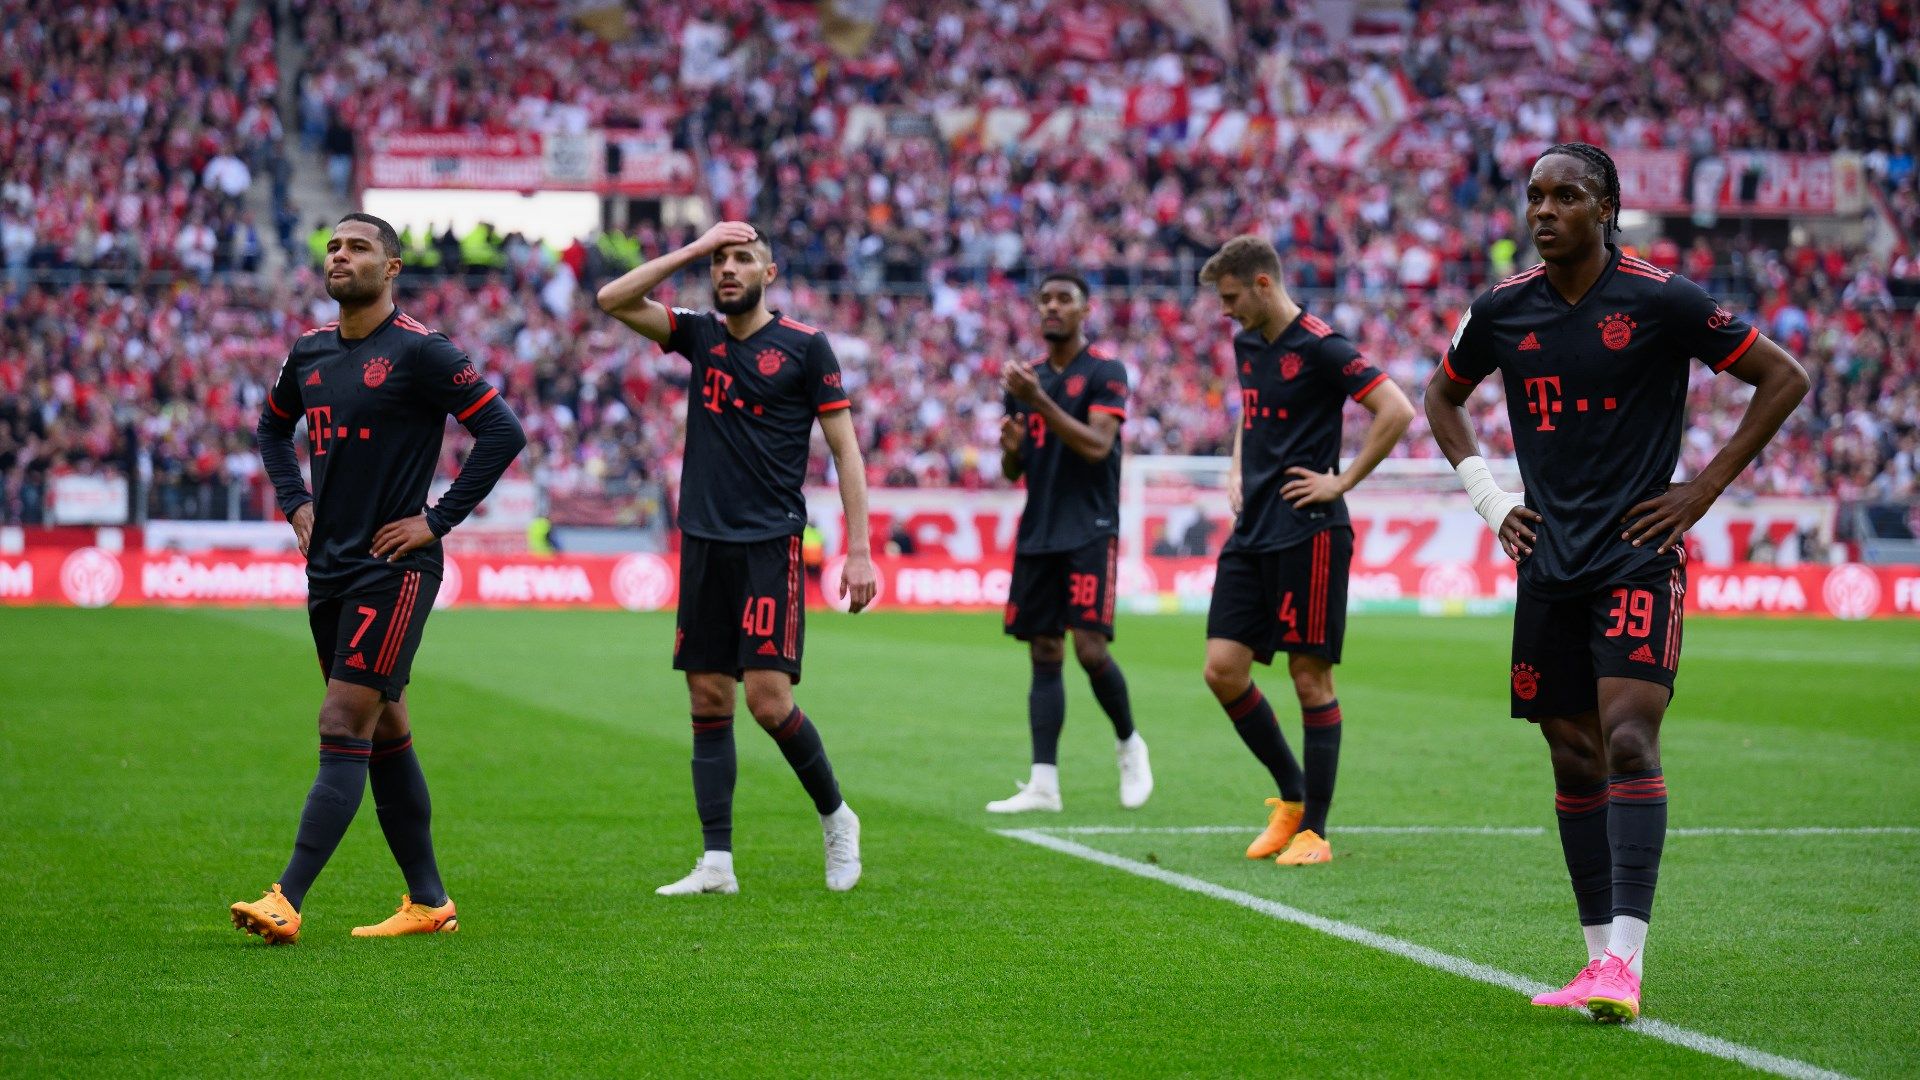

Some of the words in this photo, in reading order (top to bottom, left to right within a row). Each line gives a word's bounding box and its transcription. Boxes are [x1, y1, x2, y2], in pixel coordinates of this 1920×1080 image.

[1524, 376, 1562, 431] T
[306, 406, 332, 456] T
[478, 564, 594, 601] MEWA
[1069, 573, 1099, 606] 38
[1697, 574, 1807, 612] KAPPA
[350, 605, 378, 648] 7
[742, 596, 776, 637] 40
[1279, 591, 1297, 628] 4
[1605, 588, 1653, 637] 39
[1629, 653, 1656, 665] adidas
